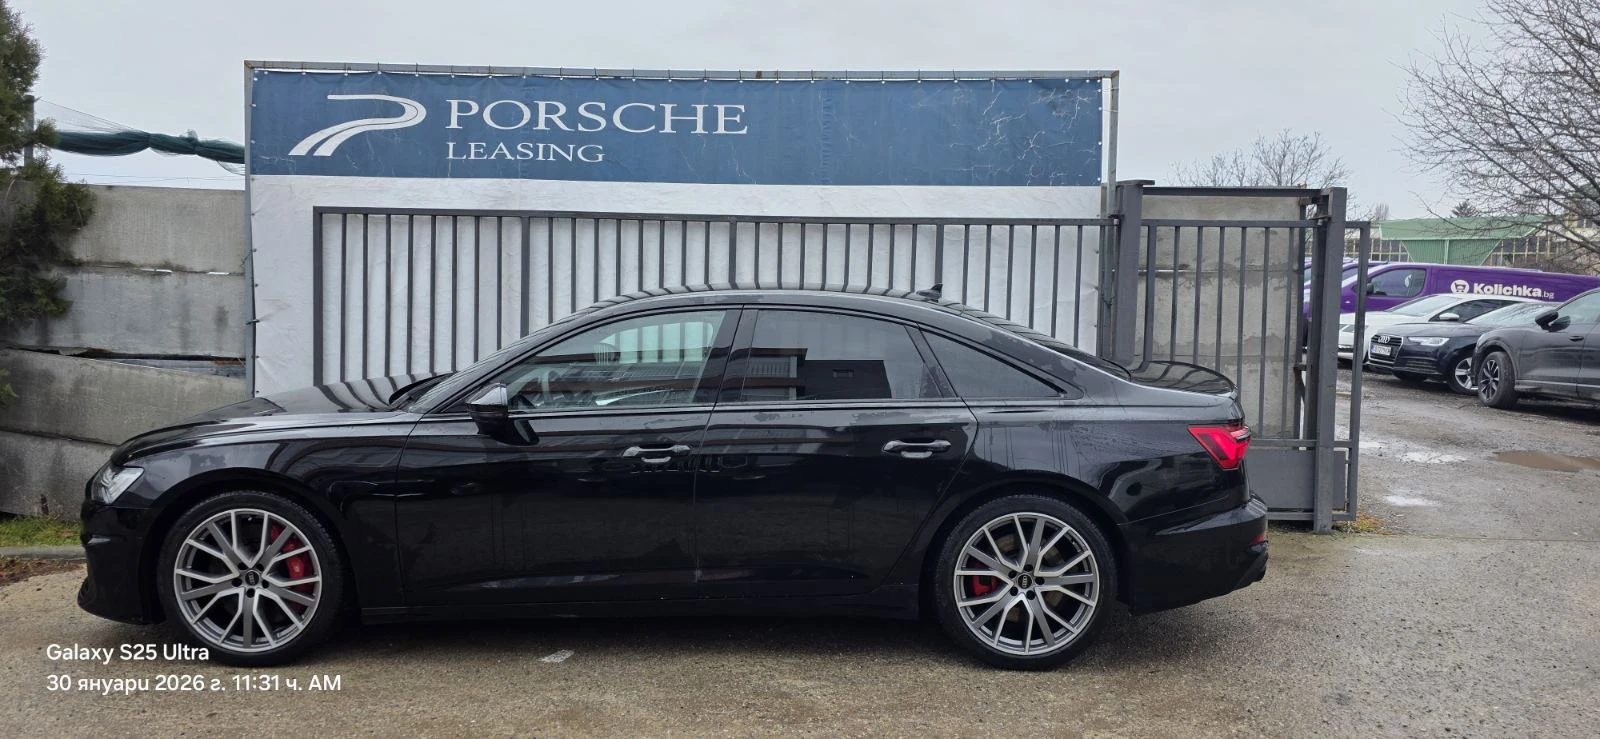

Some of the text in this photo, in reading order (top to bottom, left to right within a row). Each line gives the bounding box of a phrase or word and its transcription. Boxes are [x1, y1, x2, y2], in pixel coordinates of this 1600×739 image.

[446, 99, 748, 135] PORSCHE
[446, 142, 605, 163] LEASING
[1473, 282, 1555, 299] Kolichka.bg
